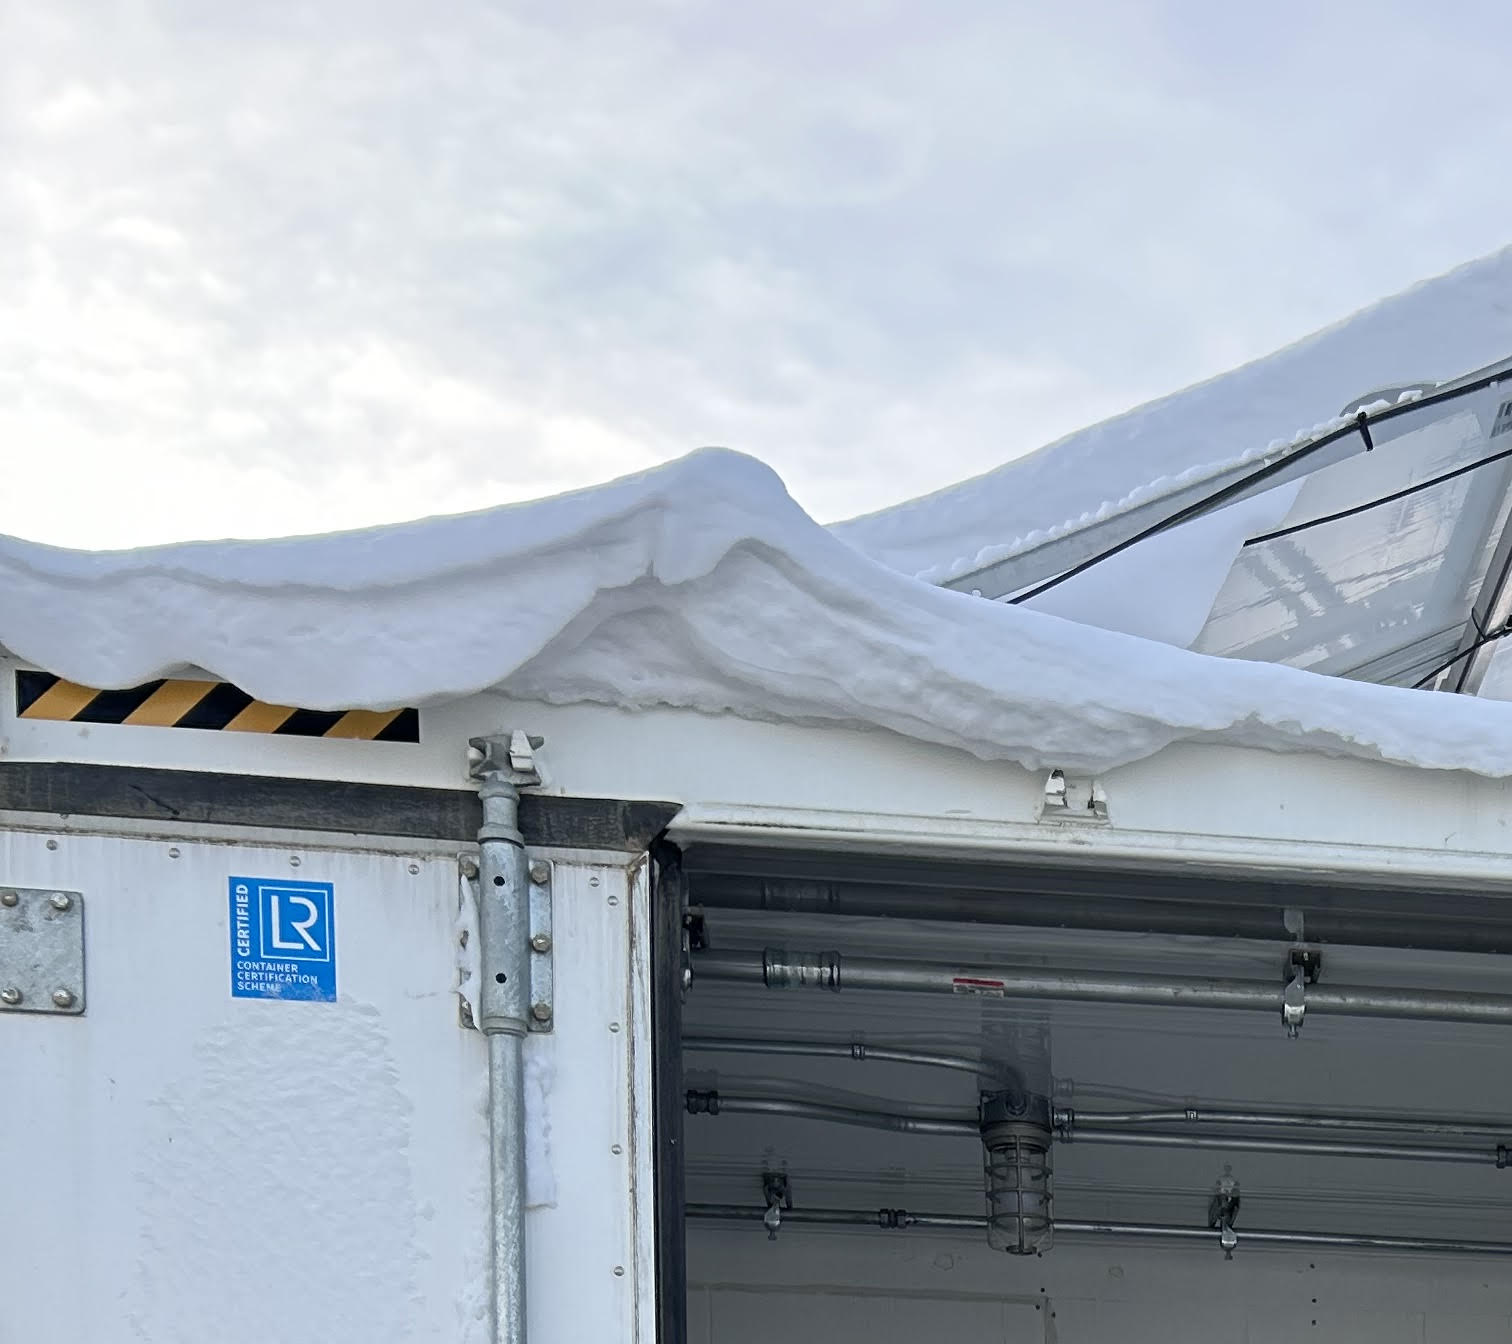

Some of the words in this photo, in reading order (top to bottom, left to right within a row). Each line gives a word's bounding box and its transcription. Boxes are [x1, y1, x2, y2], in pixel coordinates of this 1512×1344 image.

[236, 884, 250, 957] CERTIFIED
[271, 895, 322, 951] LR
[237, 961, 298, 972] CONTAINER
[237, 972, 318, 984] CERTIFICATION
[237, 981, 281, 992] SCHEME
